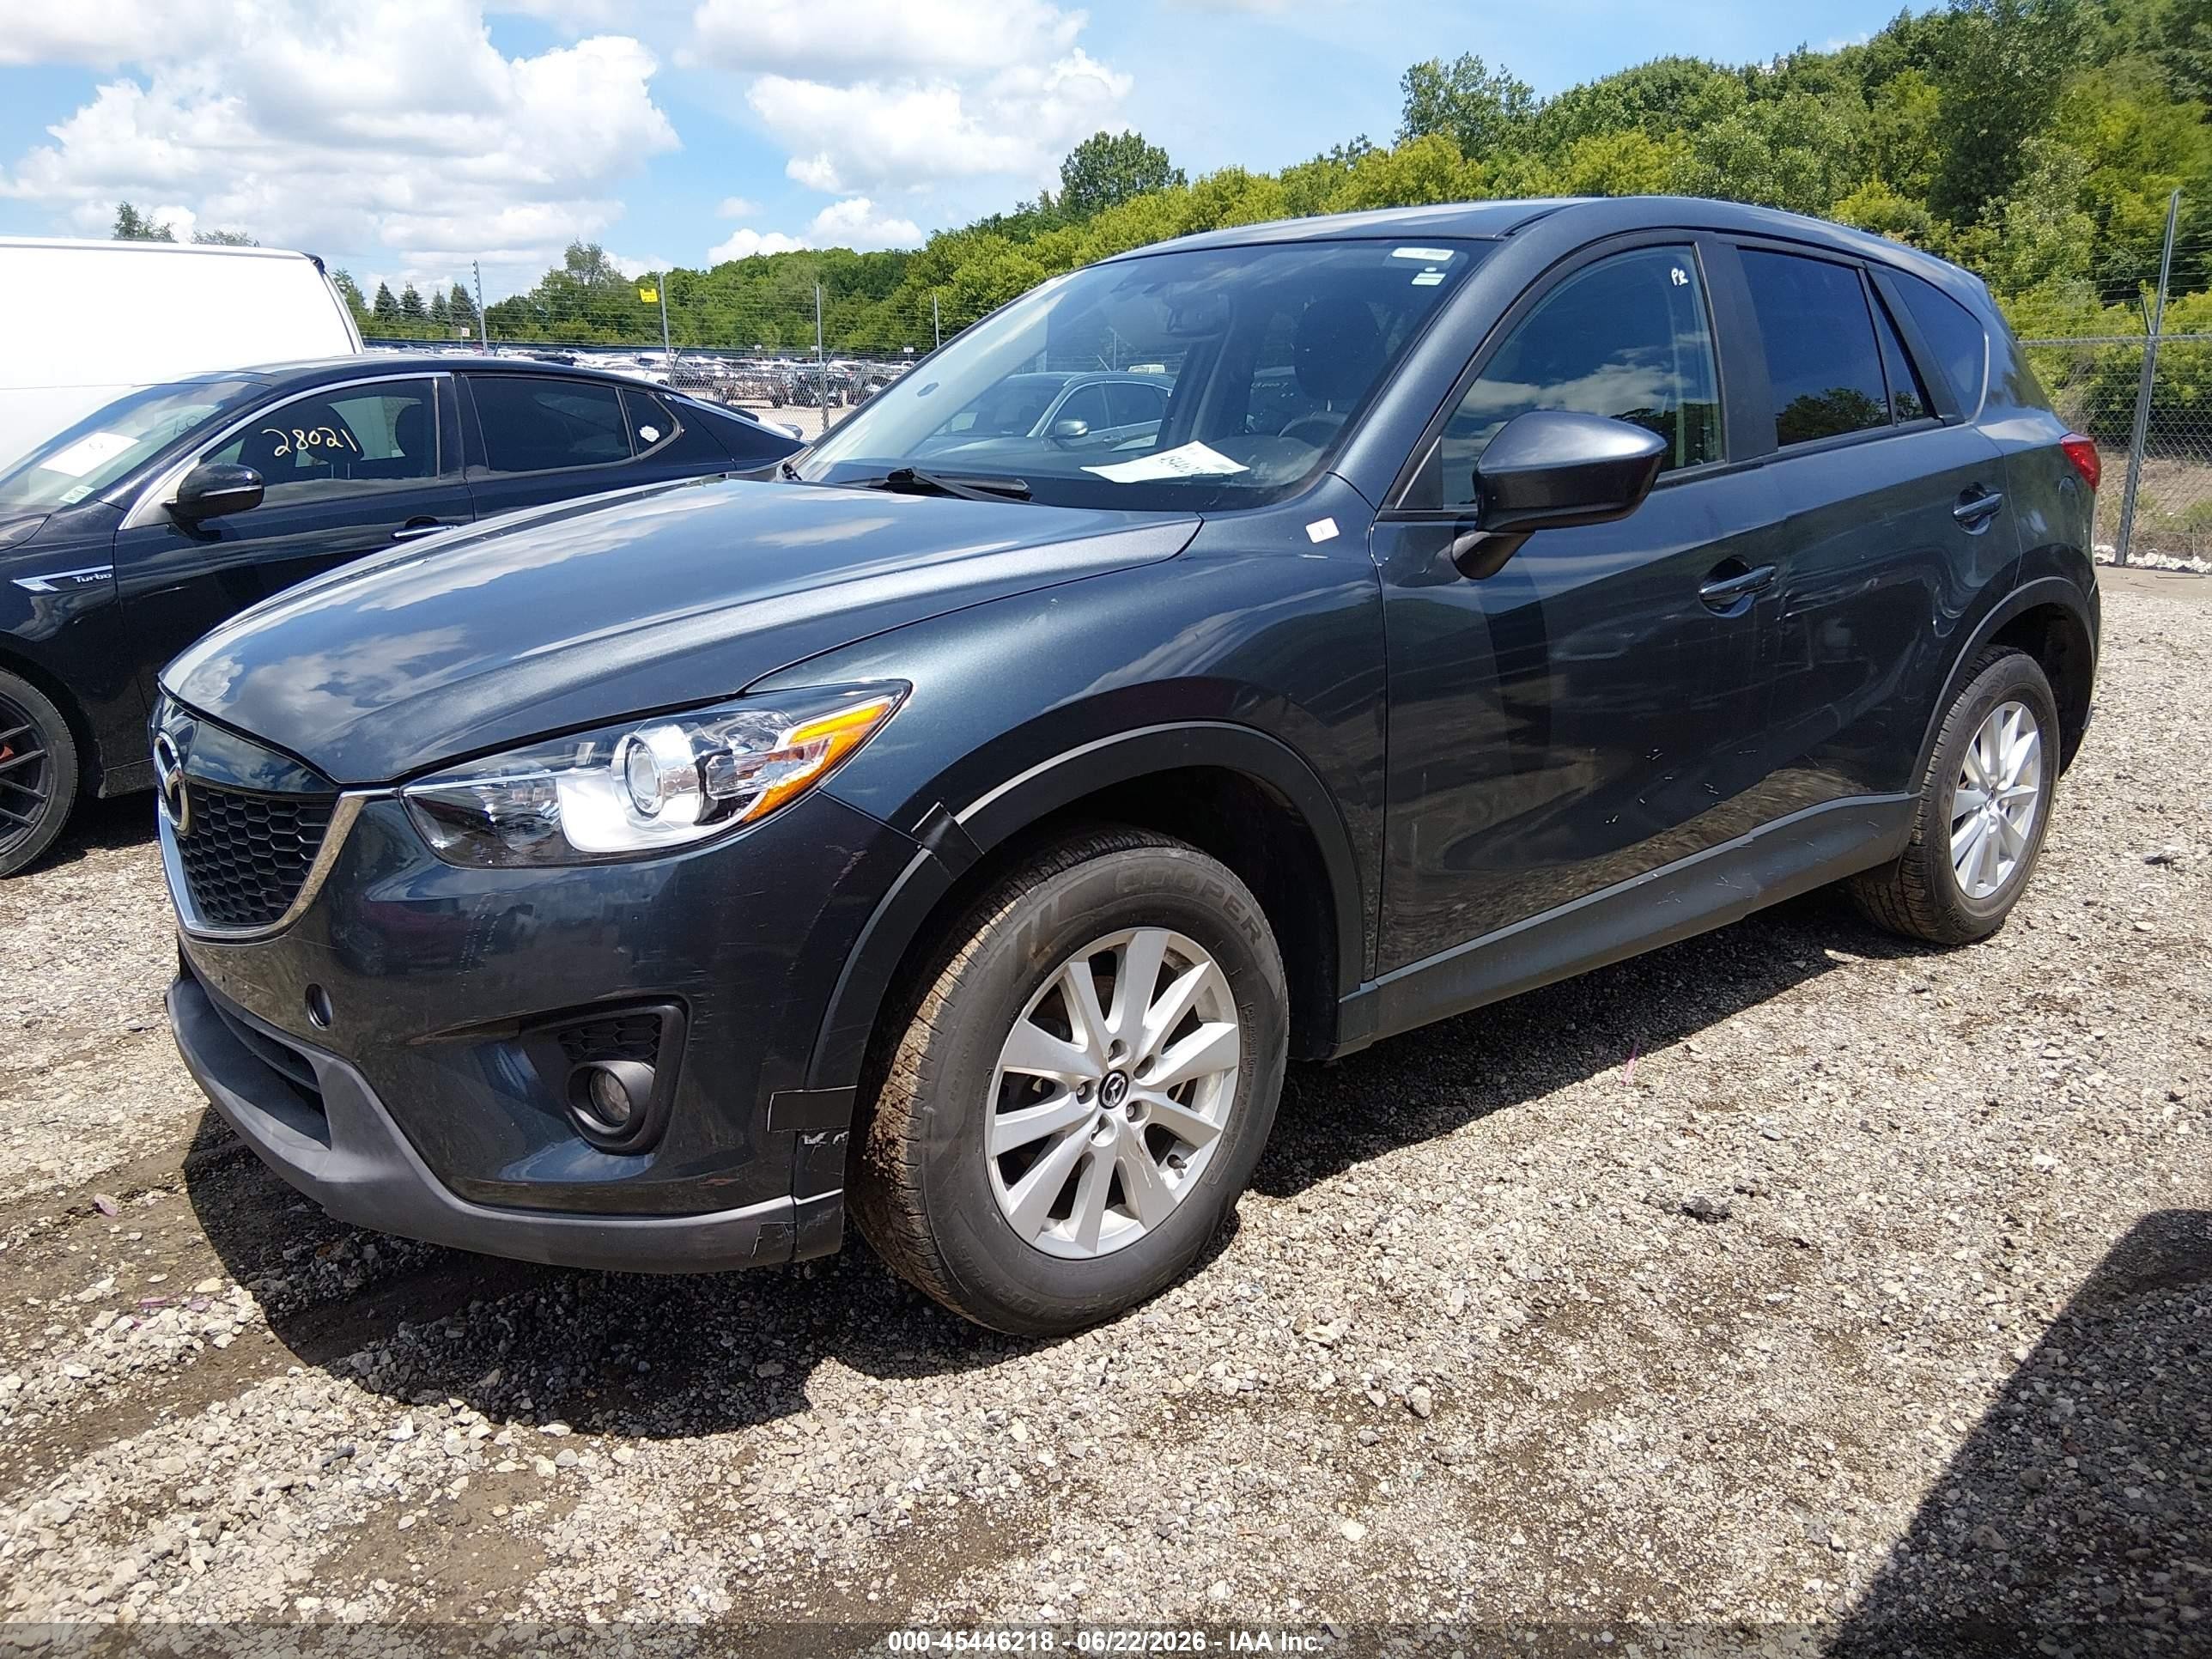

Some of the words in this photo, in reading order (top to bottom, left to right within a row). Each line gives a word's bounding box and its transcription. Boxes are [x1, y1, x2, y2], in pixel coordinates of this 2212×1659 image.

[260, 427, 357, 458] 28021
[71, 573, 112, 583] Turbo
[1115, 864, 1263, 947] COOPER
